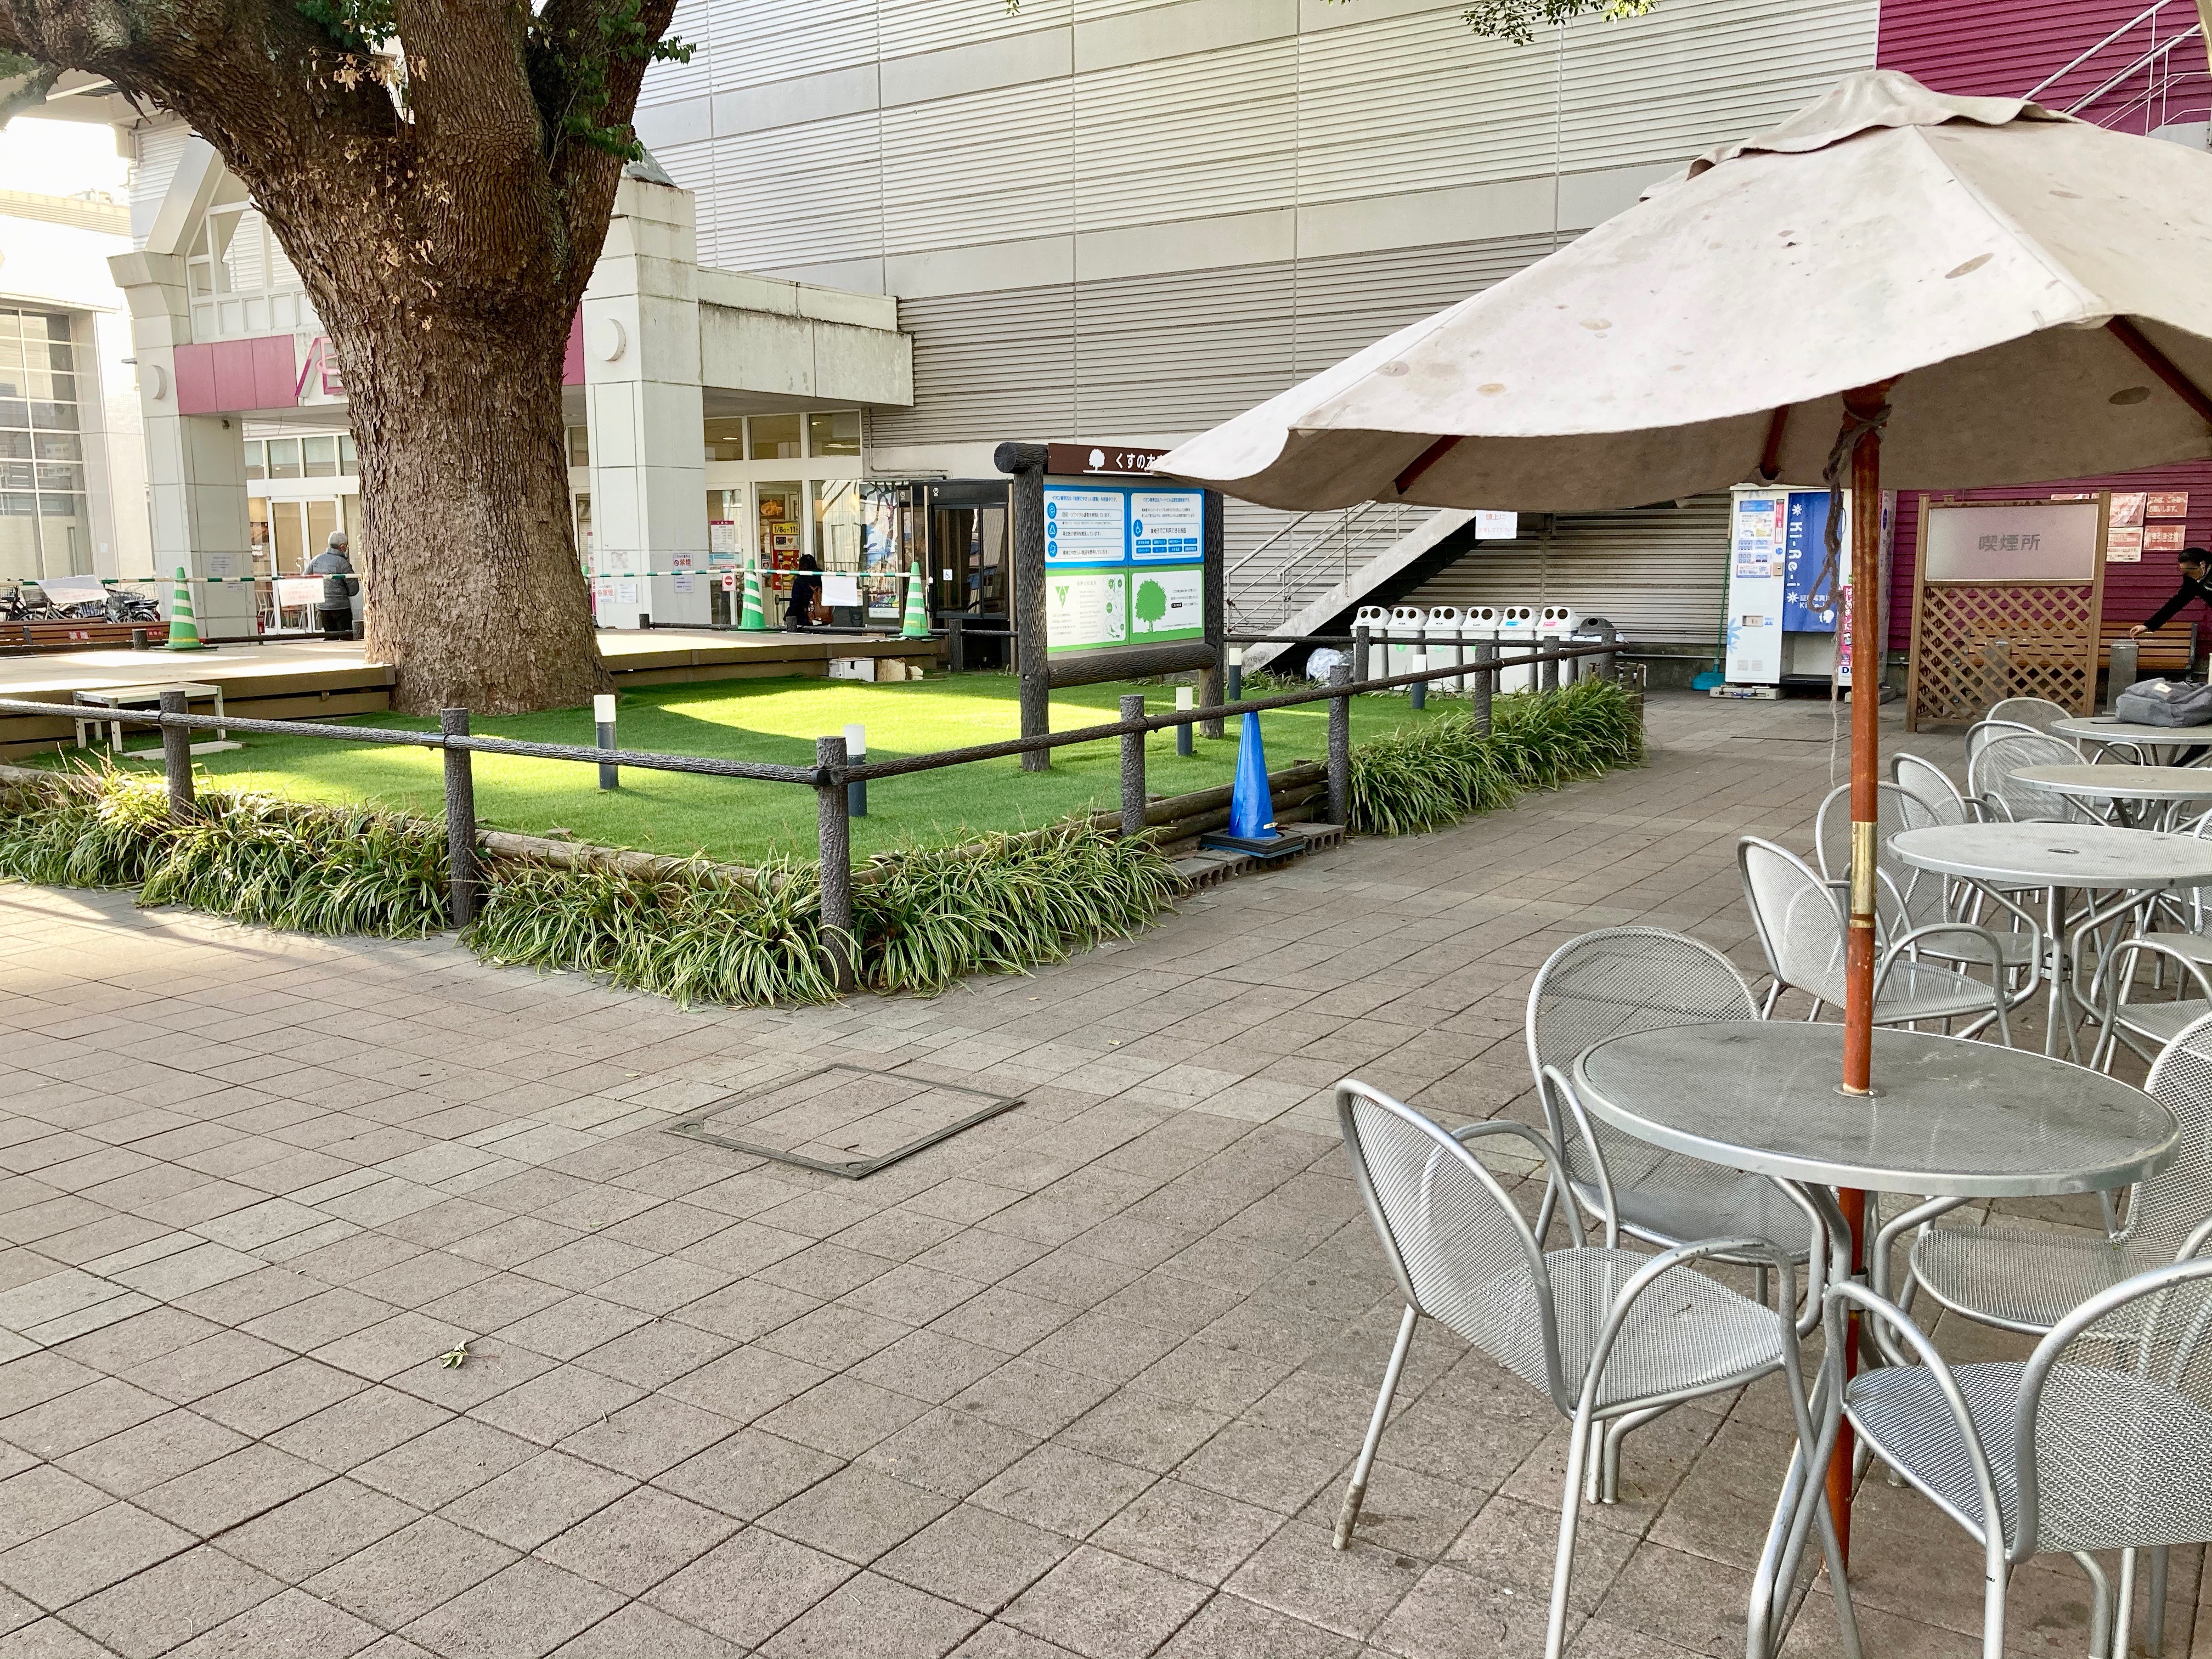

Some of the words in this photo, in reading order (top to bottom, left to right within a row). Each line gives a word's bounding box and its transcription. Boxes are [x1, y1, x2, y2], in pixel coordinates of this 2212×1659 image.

[1786, 522, 1803, 586] Ki-Re-i
[1979, 534, 2040, 552] 喫煙所
